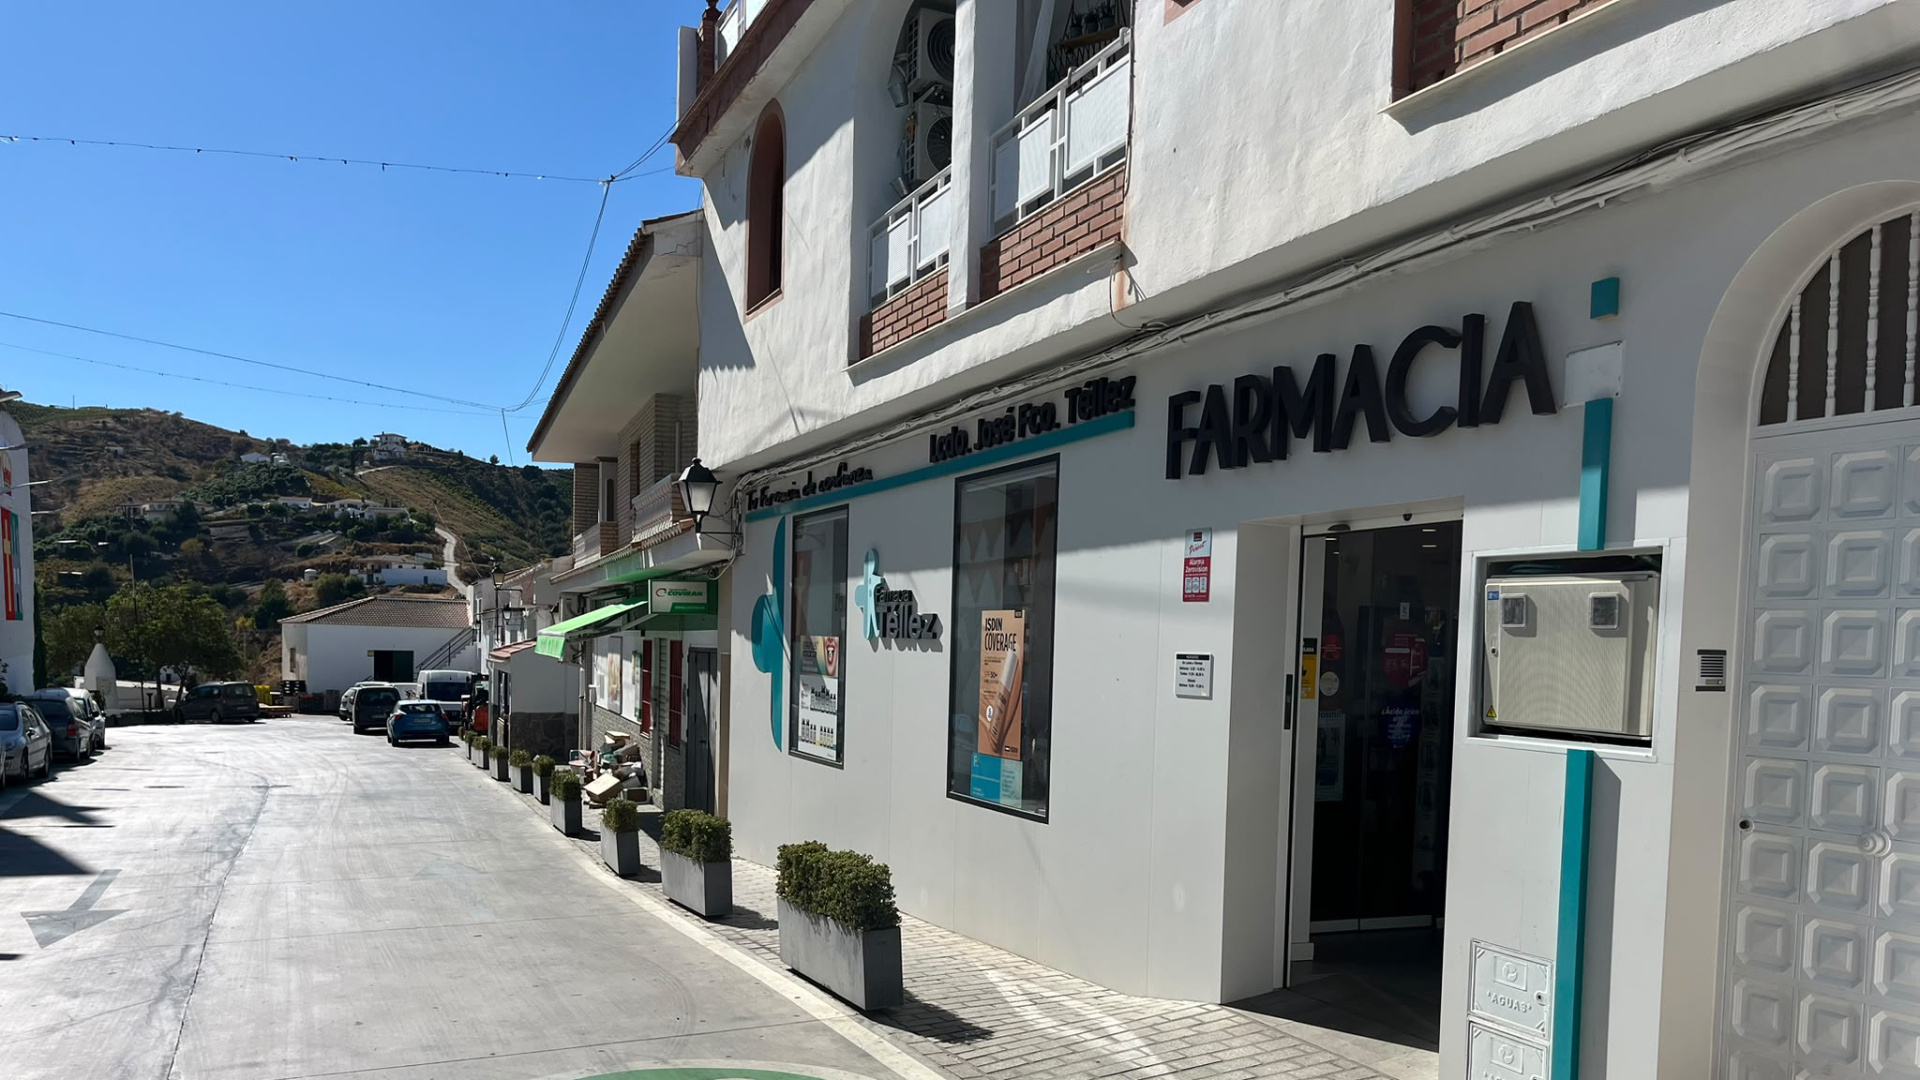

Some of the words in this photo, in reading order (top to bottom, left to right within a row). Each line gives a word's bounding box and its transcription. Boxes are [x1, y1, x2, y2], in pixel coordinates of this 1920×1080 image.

[1165, 300, 1558, 480] FARMACIA
[929, 426, 972, 463] Lcdo.
[973, 406, 1016, 450] José
[1018, 402, 1061, 438] Fco.
[1064, 375, 1136, 424] Téllez
[802, 470, 817, 496] de
[876, 604, 937, 639] Téllez
[985, 617, 1003, 632] ISDIN
[984, 632, 1017, 652] COVERAGE
